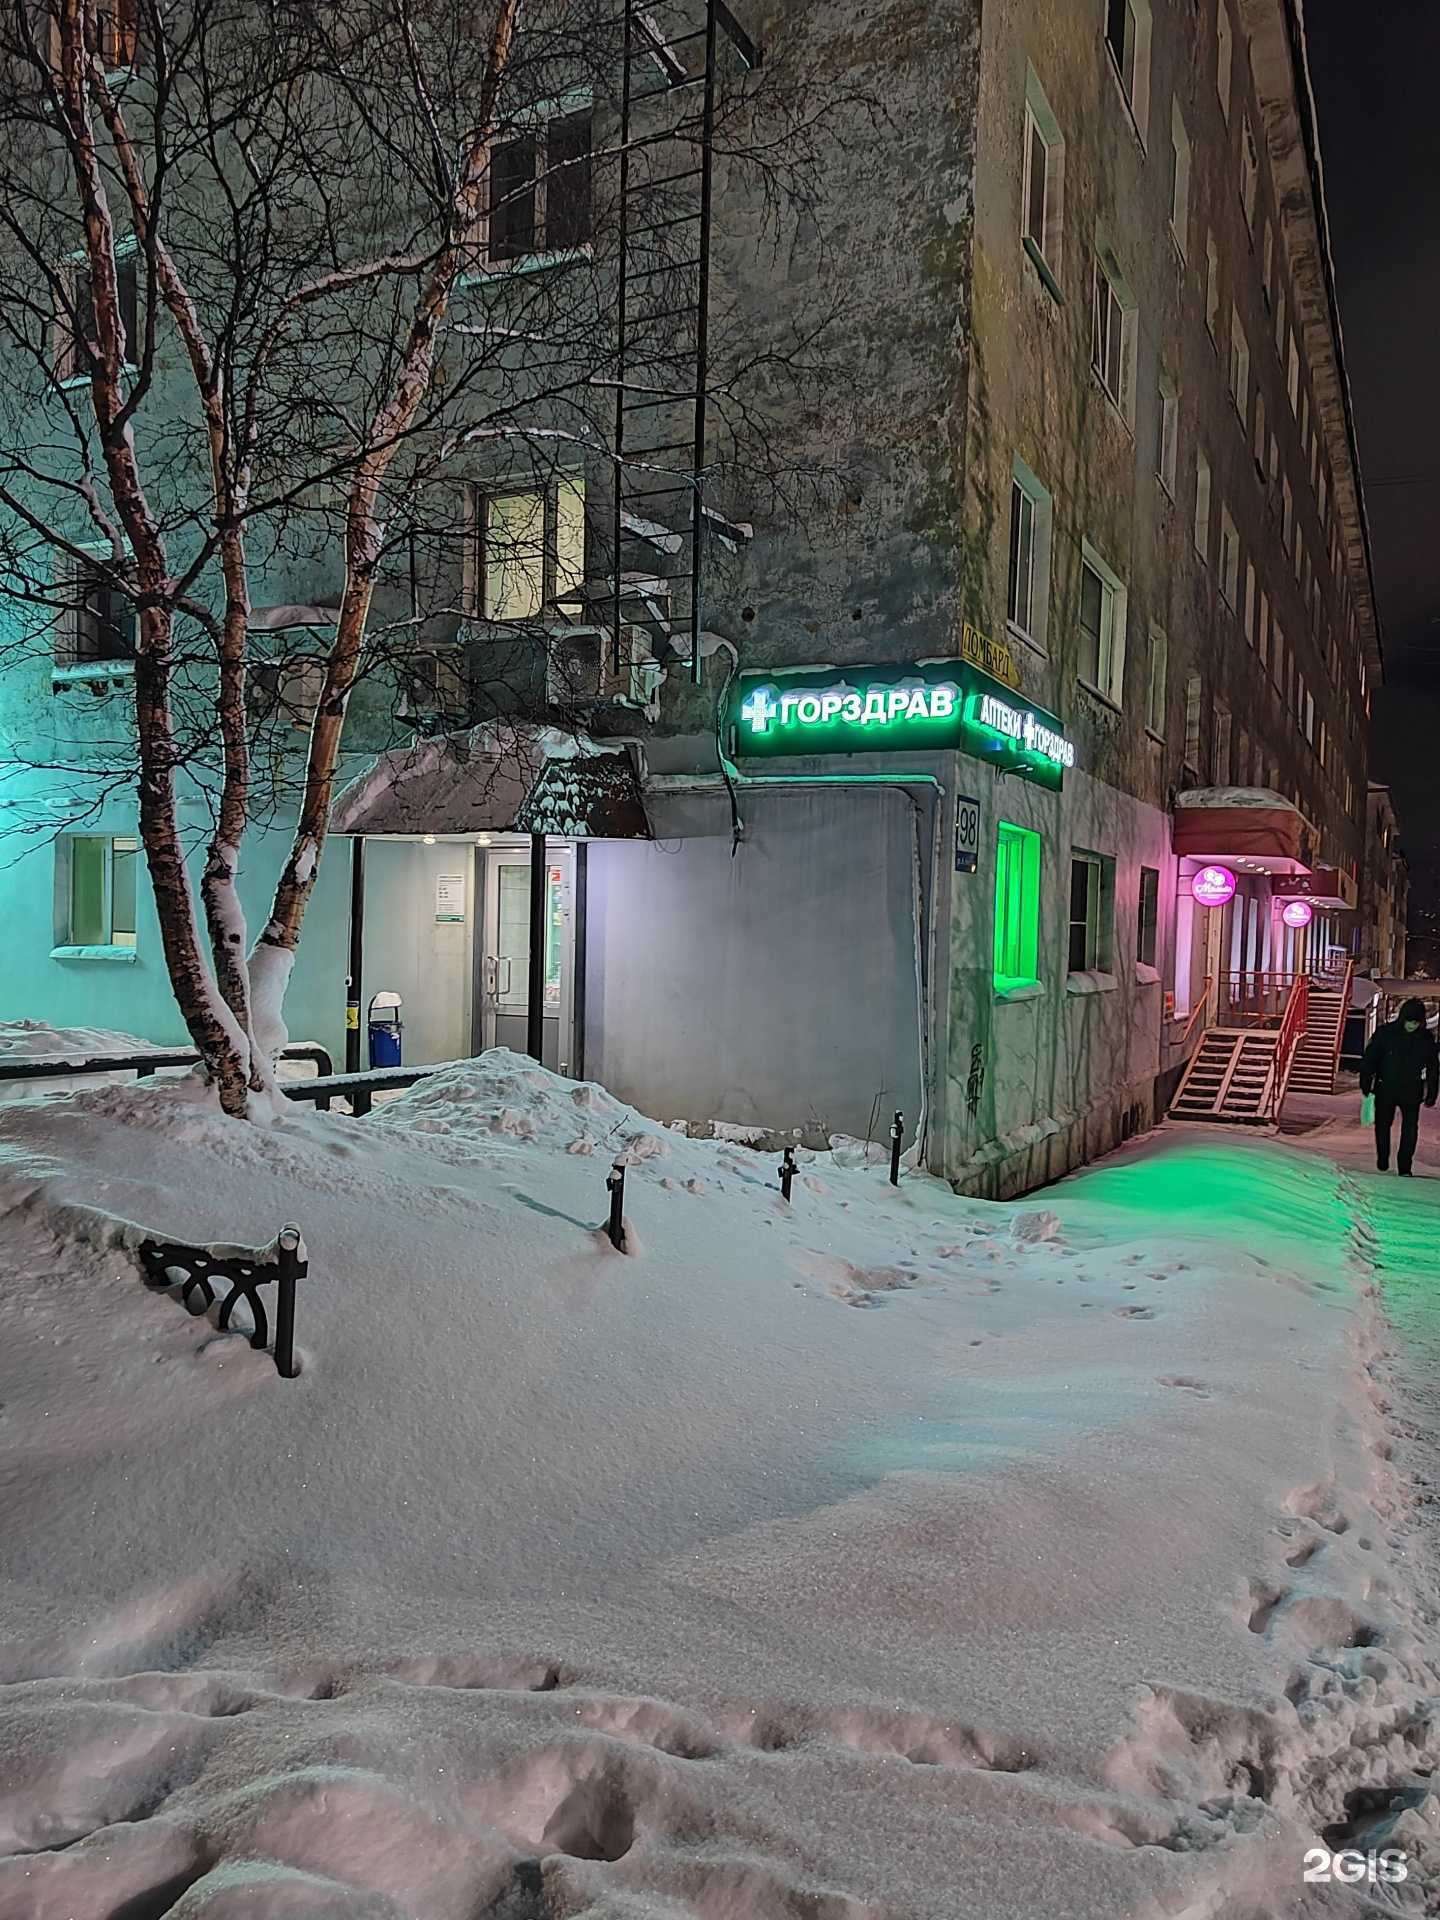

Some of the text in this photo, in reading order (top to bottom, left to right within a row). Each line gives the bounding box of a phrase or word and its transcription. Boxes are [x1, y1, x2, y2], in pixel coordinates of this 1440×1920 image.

[964, 627, 1010, 678] ЛОМБАРД
[780, 690, 953, 726] ГОРЗДРАВ
[980, 694, 1075, 768] АПТЕКИ ГОРЗДРАВ
[960, 807, 976, 846] 98
